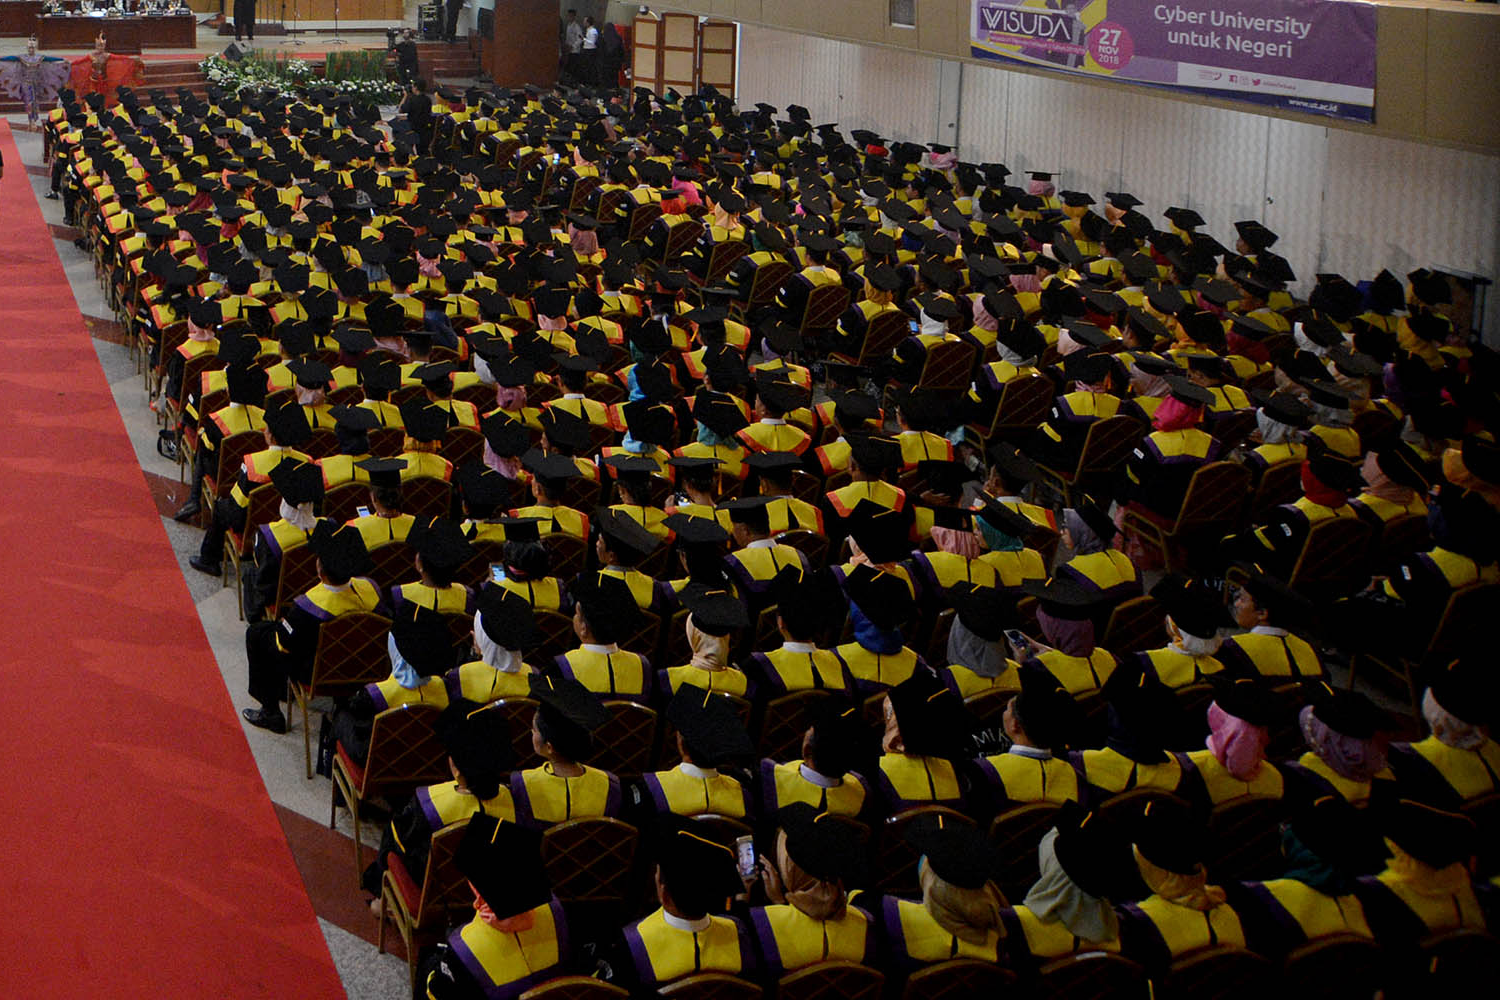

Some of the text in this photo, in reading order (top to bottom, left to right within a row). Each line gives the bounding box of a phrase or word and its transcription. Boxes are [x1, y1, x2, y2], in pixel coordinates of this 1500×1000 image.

[982, 7, 1070, 40] WISUDA
[1154, 4, 1312, 39] Cyber University
[1099, 28, 1122, 46] 27
[1168, 31, 1293, 58] untuk Negeri
[1099, 46, 1119, 55] NOV
[1099, 54, 1119, 64] 2018
